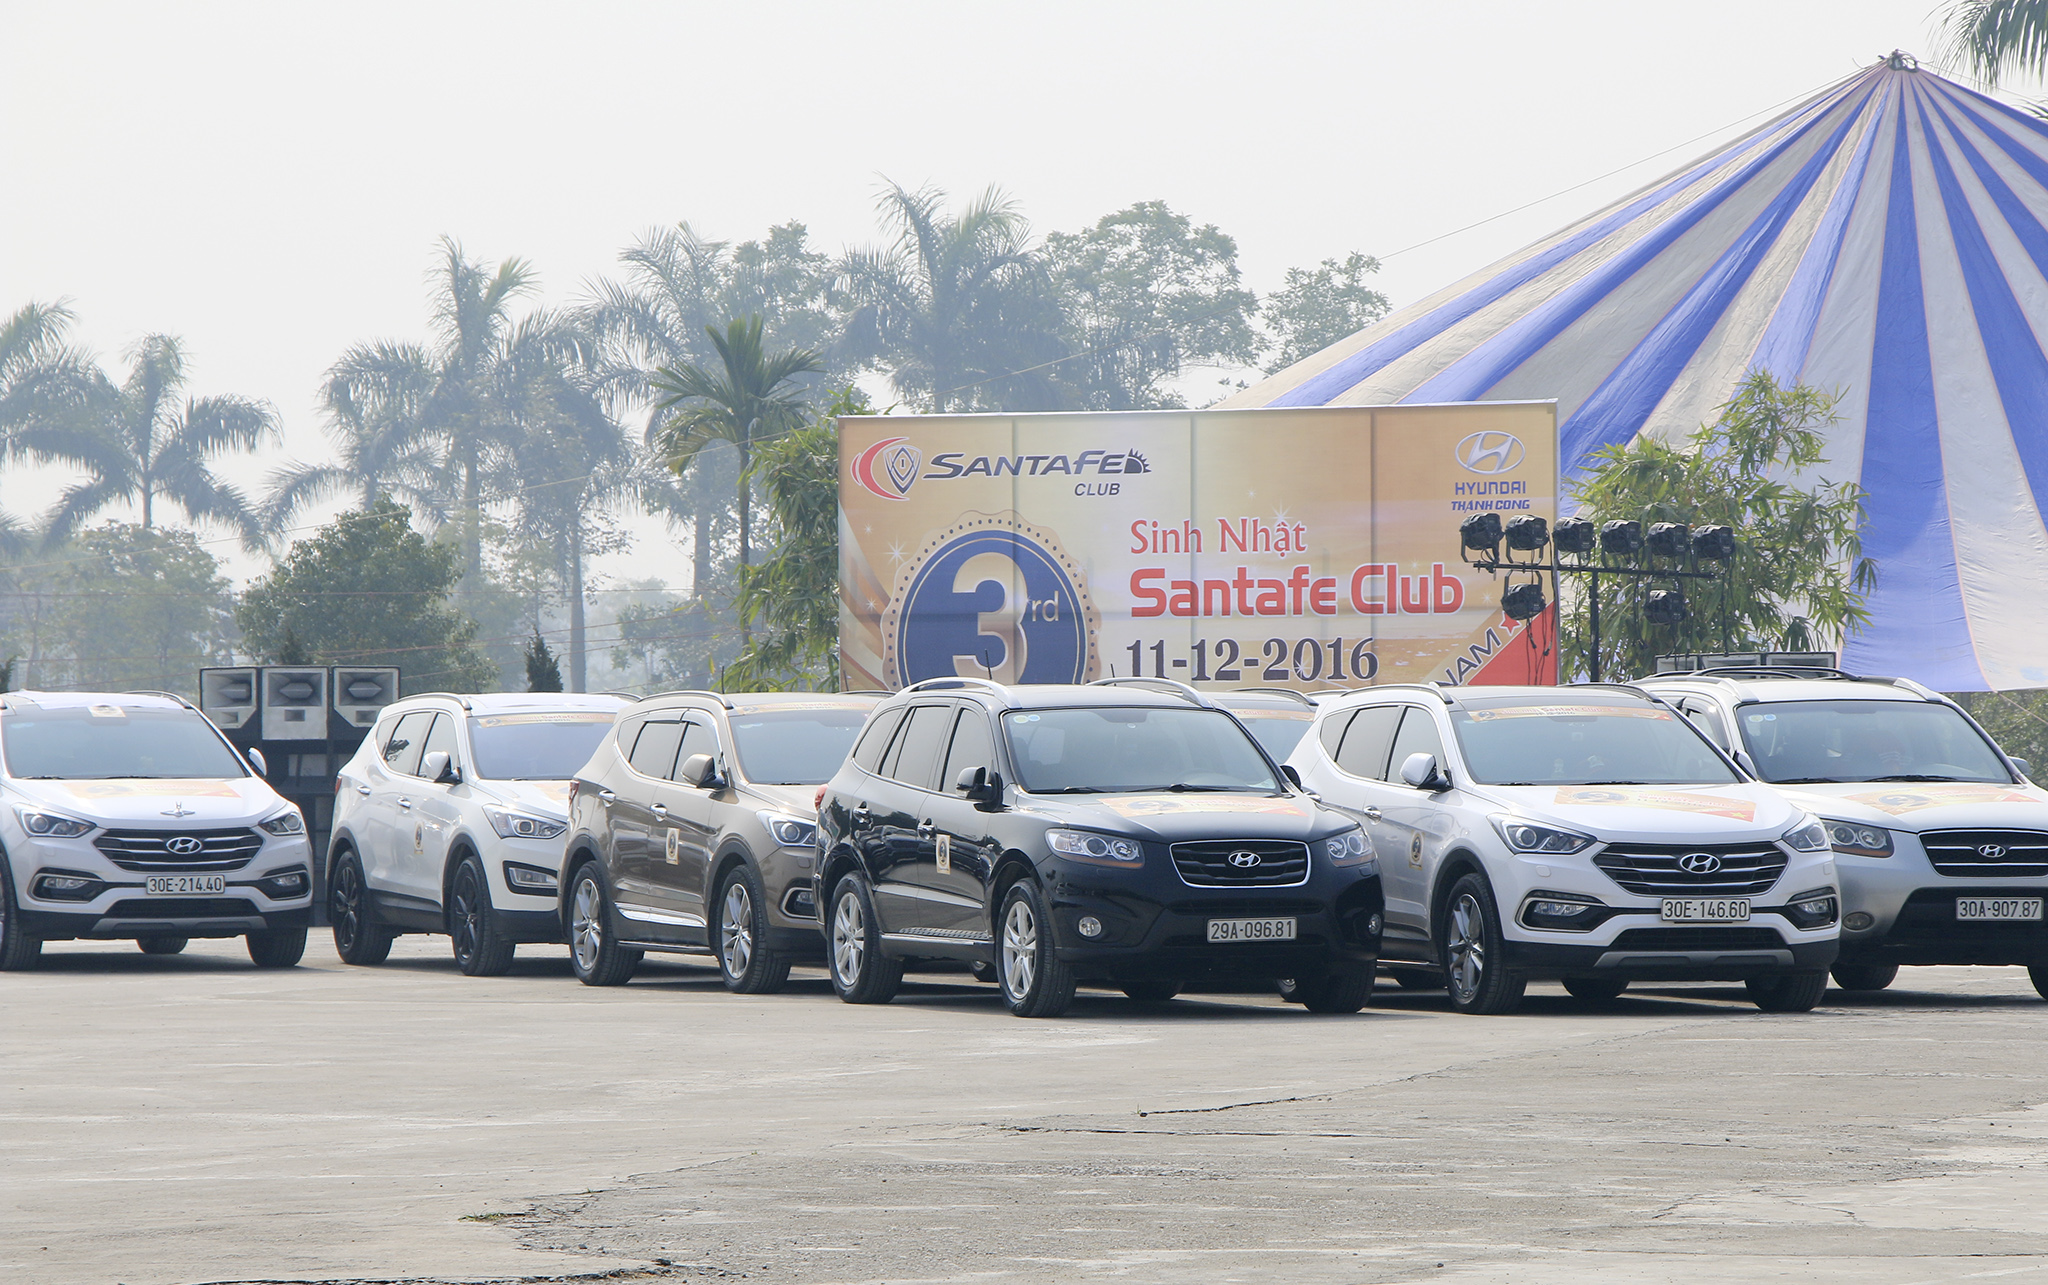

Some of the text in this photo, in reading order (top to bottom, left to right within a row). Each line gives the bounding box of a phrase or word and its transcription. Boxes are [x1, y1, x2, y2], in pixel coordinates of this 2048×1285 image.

[923, 449, 1126, 480] SANTAFE
[1074, 482, 1121, 496] CLUB
[1455, 481, 1526, 495] HYUNDAI
[1130, 516, 1308, 558] Sinh Nhật
[1129, 562, 1464, 618] Santafe Club
[1126, 637, 1379, 682] 11-12-2016
[149, 877, 222, 892] 30E-214.40
[1664, 900, 1747, 919] 30E-146.60
[1959, 900, 2040, 918] 30A-907.87
[1210, 920, 1292, 940] 29A-096.81
